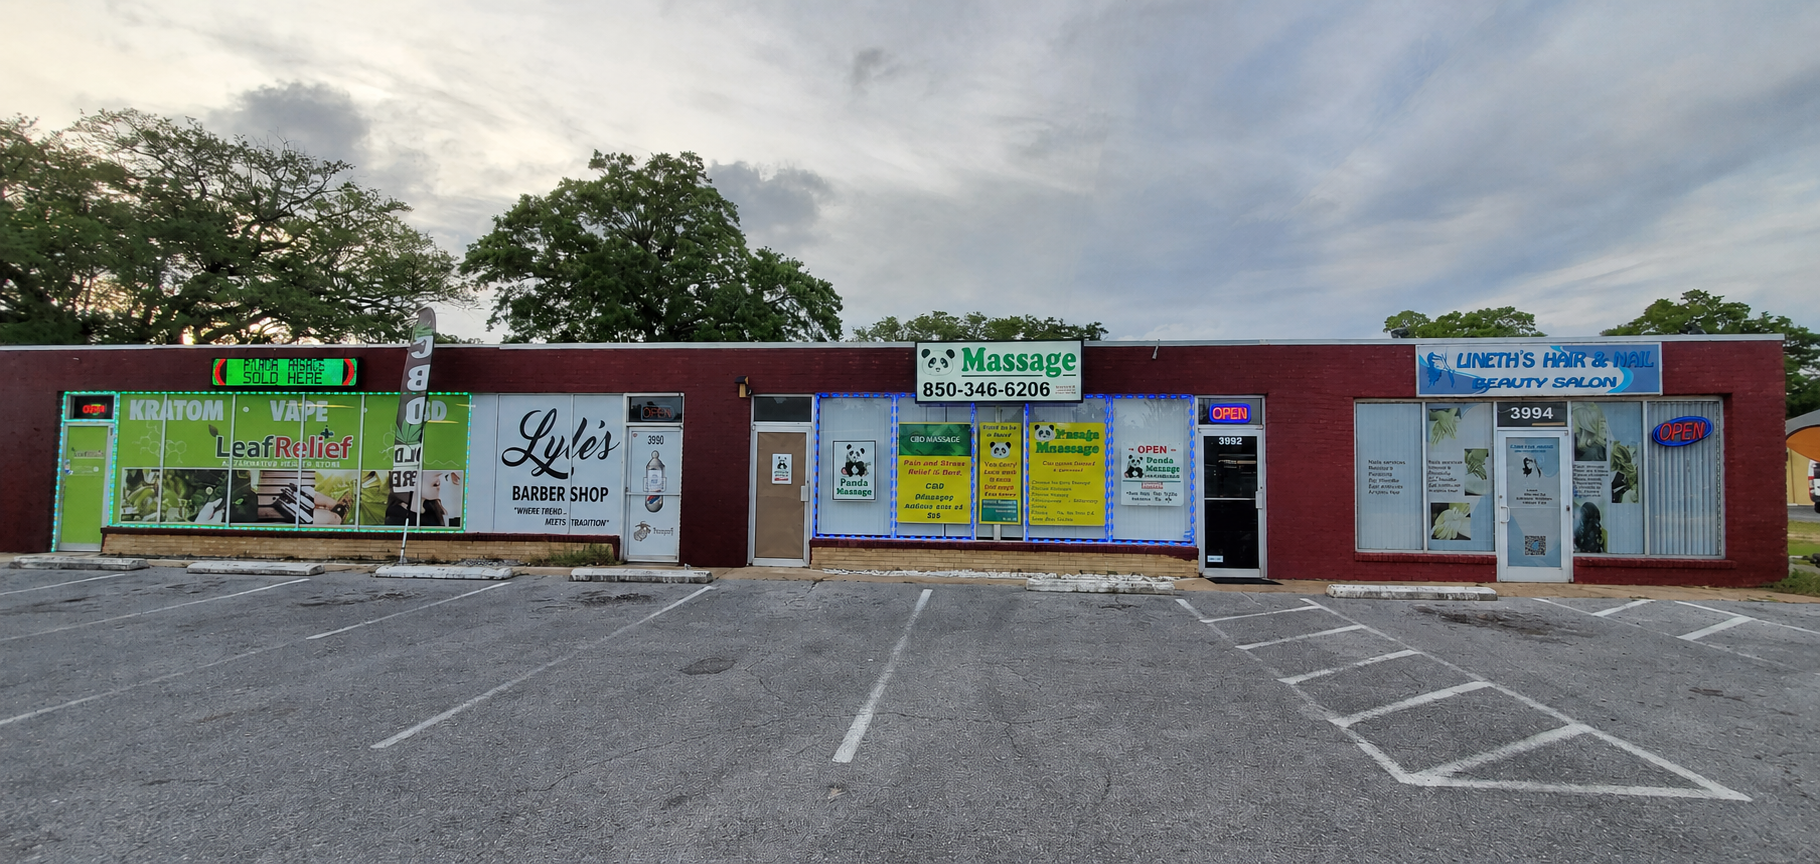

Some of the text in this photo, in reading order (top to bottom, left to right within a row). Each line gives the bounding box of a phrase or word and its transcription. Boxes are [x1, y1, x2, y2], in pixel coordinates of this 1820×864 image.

[961, 347, 1077, 378] Massage
[1456, 350, 1654, 369] LINETH'S HAIR & NAIL
[243, 372, 323, 384] SOLD HERE
[1472, 376, 1617, 390] BEAUTY SALON
[923, 382, 1051, 398] 850-346-6206
[129, 399, 329, 422] KRATOM VAPE
[1212, 406, 1248, 420] OPEN
[1510, 407, 1554, 420] 3994
[1659, 422, 1706, 441] OPEN
[501, 408, 621, 480] Lyle's
[647, 435, 664, 445] 3990
[1218, 437, 1243, 445] 3992
[1137, 445, 1168, 454] OPEN
[840, 478, 869, 487] Panda
[512, 485, 609, 502] BARBER SHOP
